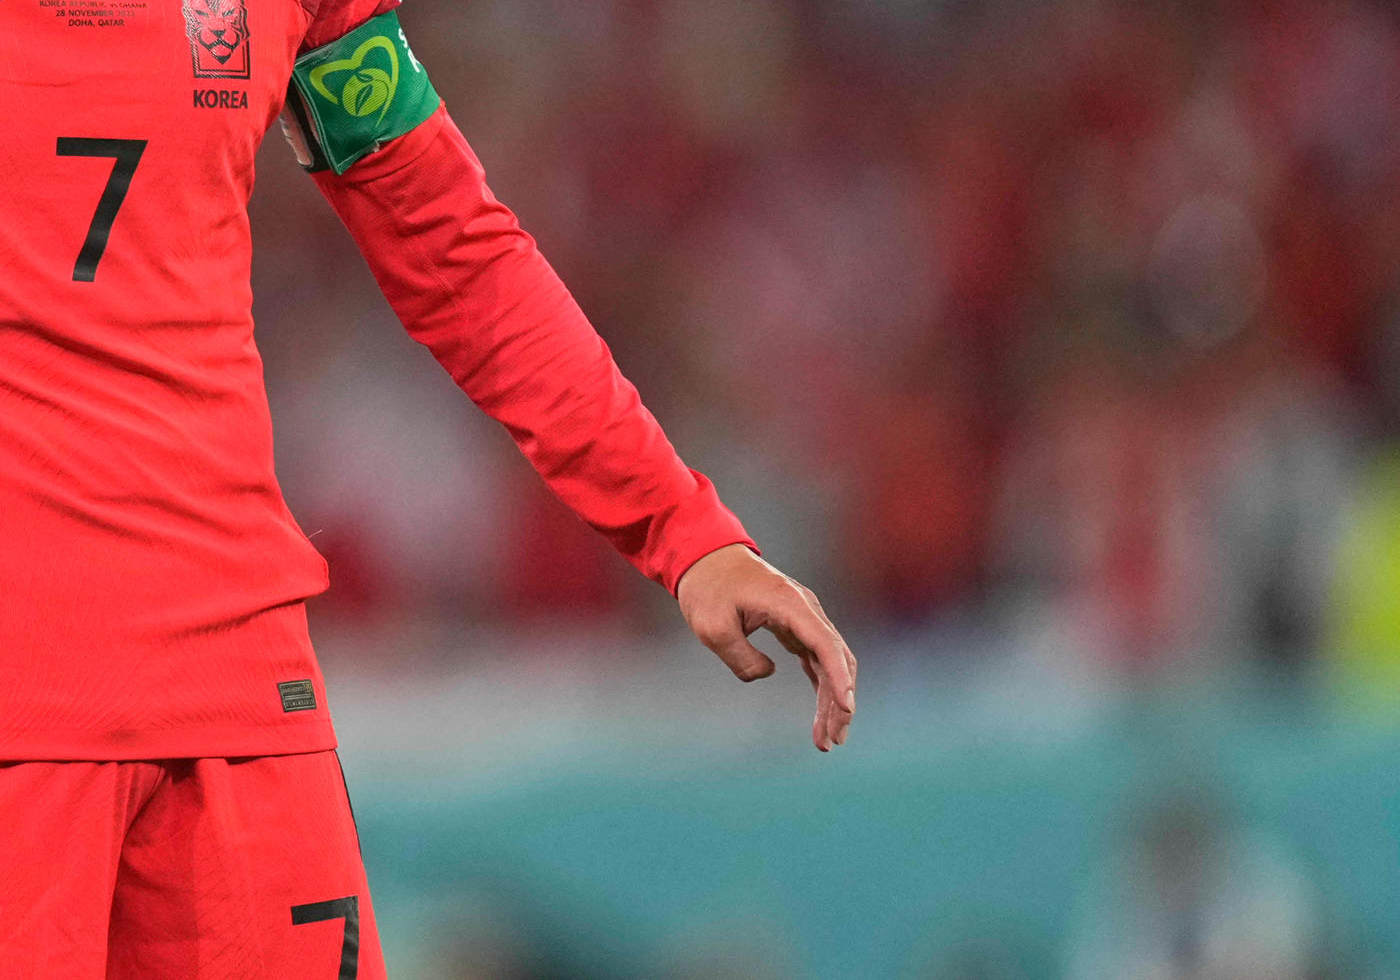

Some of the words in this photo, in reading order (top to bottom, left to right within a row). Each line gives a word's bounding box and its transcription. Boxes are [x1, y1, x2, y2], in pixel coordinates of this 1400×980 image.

[68, 19, 96, 27] DOHA,
[98, 19, 125, 27] QATAR
[193, 89, 249, 110] KOREA
[56, 137, 148, 282] 7
[290, 895, 359, 980] 7
